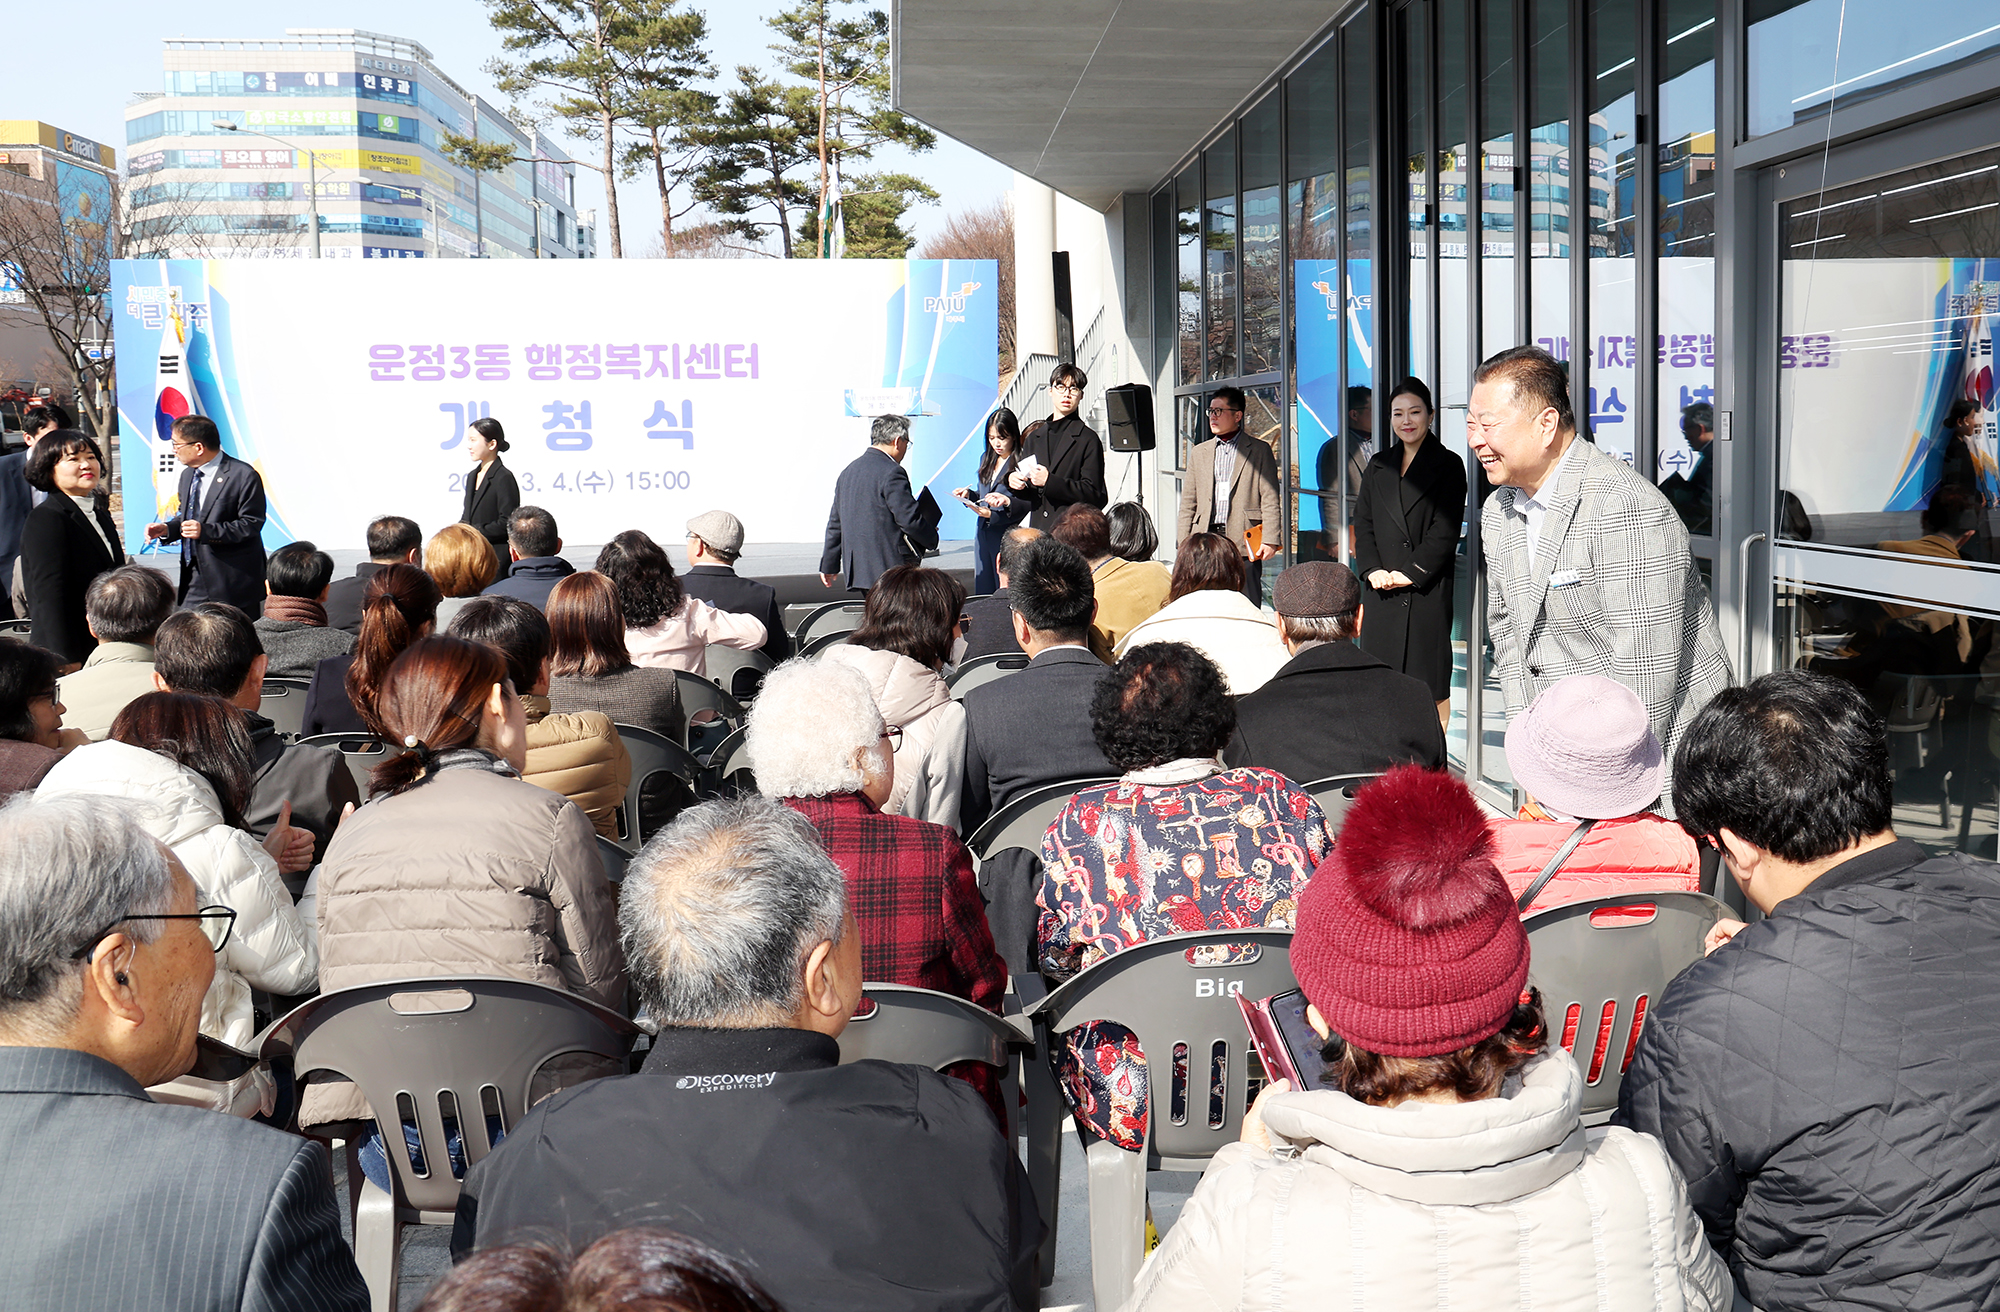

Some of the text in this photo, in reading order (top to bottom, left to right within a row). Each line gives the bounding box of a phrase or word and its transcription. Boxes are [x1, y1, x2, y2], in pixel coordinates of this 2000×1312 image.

[264, 111, 352, 124] 한국소방안전원
[63, 133, 96, 160] emart
[142, 303, 163, 329] 큰
[925, 297, 965, 314] PAJU
[368, 342, 759, 381] 운정3동 행정복지센터
[626, 470, 691, 490] 15:00
[1195, 977, 1244, 999] Big
[700, 1082, 763, 1094] EXPEDITION
